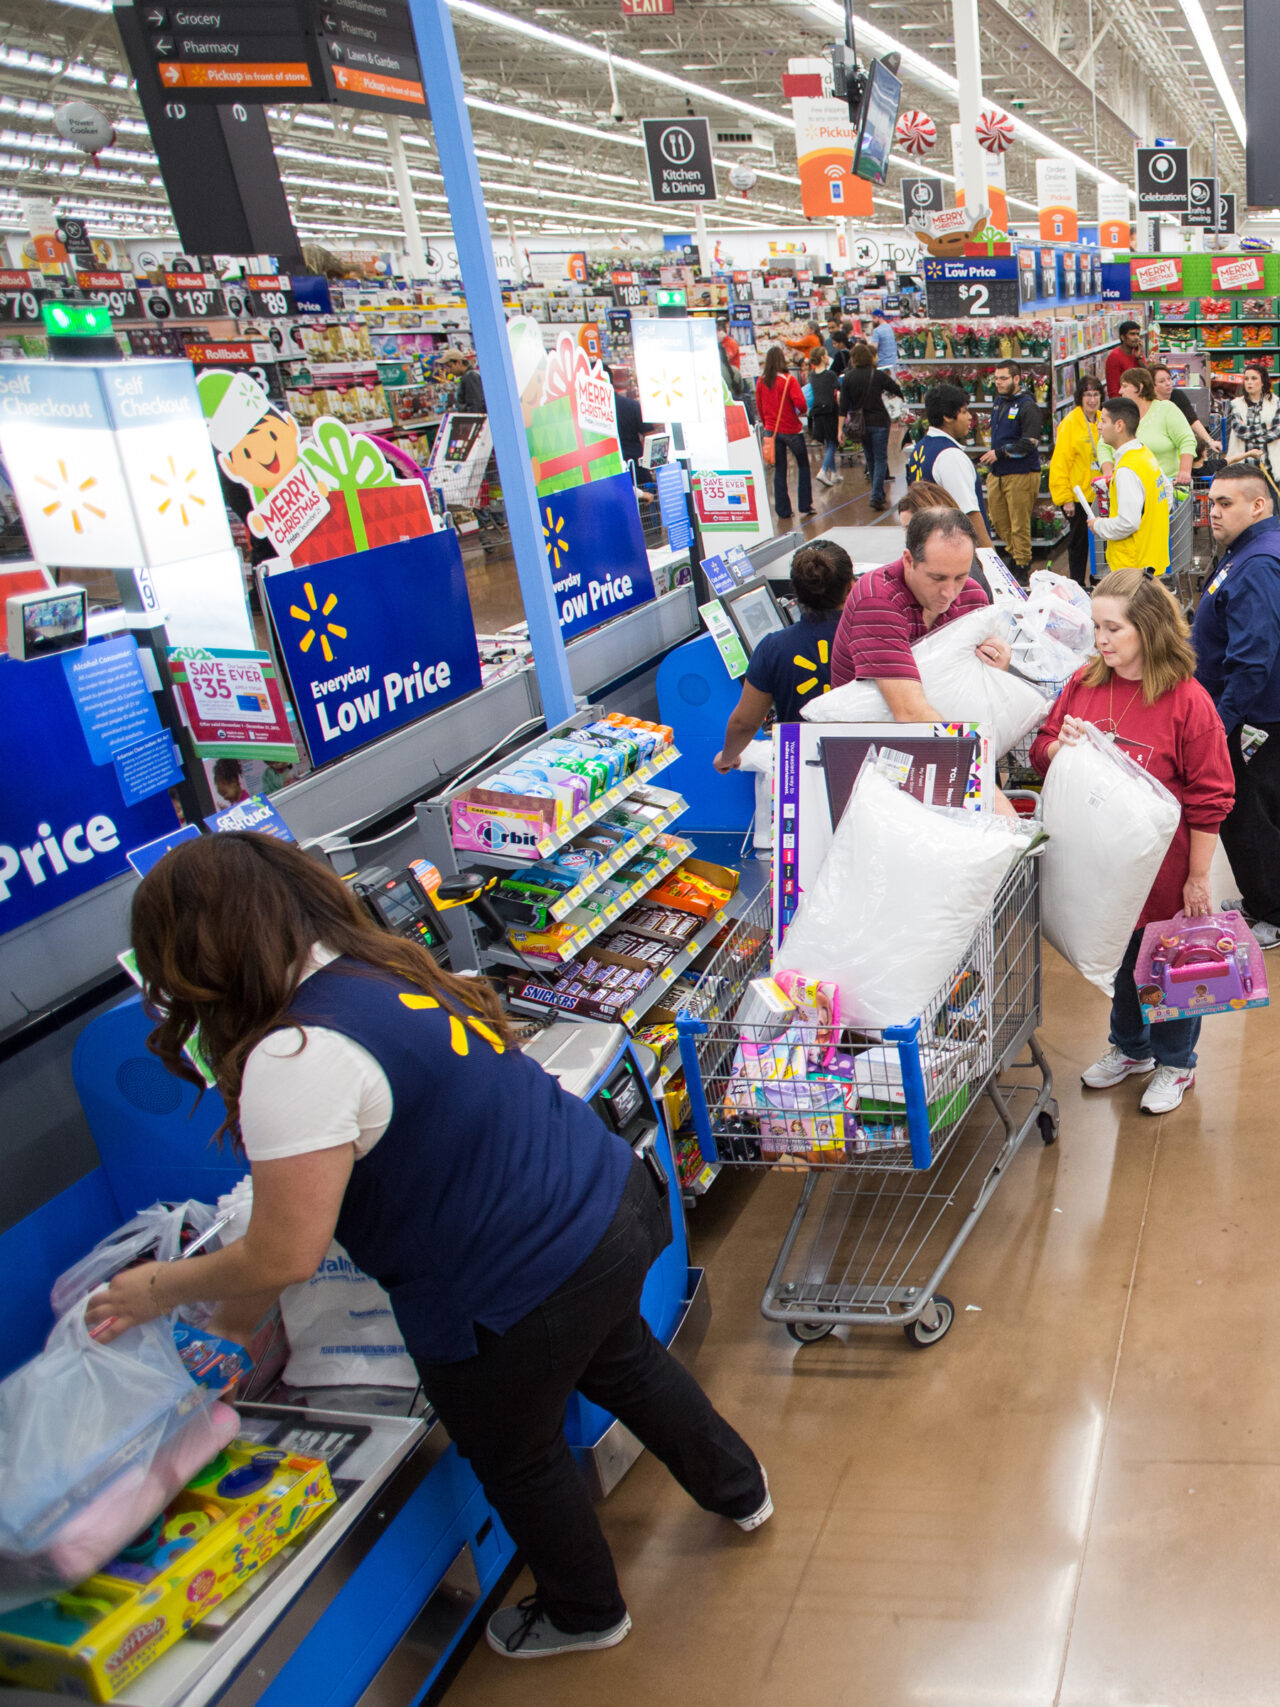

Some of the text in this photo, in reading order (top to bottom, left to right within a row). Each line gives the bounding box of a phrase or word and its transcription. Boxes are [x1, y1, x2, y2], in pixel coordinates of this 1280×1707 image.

[633, 0, 664, 13] EXIT
[176, 12, 221, 28] Grocery
[341, 20, 378, 42] Pharmacy
[184, 41, 239, 56] Pharmacy
[347, 49, 367, 63] Lawn
[374, 54, 400, 70] Garden
[208, 70, 308, 83] Pickup in front of store.
[363, 77, 386, 93] Pickup
[69, 118, 94, 128] Power
[70, 126, 99, 136] Cooker
[820, 127, 858, 140] Pickup
[663, 169, 700, 181] Kitchen
[662, 183, 706, 195] & Dining
[1140, 191, 1188, 202] Celebrations
[932, 210, 963, 223] MERRY
[945, 267, 997, 278] Low Price
[1140, 263, 1171, 278] MERRY
[1220, 262, 1252, 277] MERRY
[90, 276, 121, 287] Rollback
[178, 277, 203, 287] Rollback
[1142, 273, 1174, 285] CHRISTMAS
[1222, 273, 1256, 285] CHRISTMAS
[620, 287, 640, 304] $189
[958, 284, 991, 315] $2
[1103, 289, 1121, 298] rice
[261, 292, 288, 314] $89
[298, 301, 321, 312] Price
[206, 348, 249, 361] Rollback
[114, 375, 144, 397] Self
[578, 383, 612, 406] MERRY
[3, 398, 93, 418] Checkout
[120, 396, 191, 418] Checkout
[580, 403, 615, 423] CHRISTMAS
[703, 478, 723, 487] SAVE
[261, 469, 311, 532] MERRY
[704, 487, 725, 499] $35
[274, 490, 322, 544] CHRISTMAS
[286, 529, 301, 546] Friday
[553, 572, 581, 594] veryday
[590, 573, 633, 612] Price
[189, 662, 226, 676] SAVE
[229, 670, 262, 682] EVER
[193, 678, 232, 699] $35
[310, 664, 371, 700] Everyday
[316, 660, 452, 742] Low Price
[949, 767, 958, 784] TCL
[246, 804, 275, 827] QUICK
[482, 827, 539, 848] Orbit
[0, 814, 121, 901] Price
[522, 984, 579, 1009] SNICKERS
